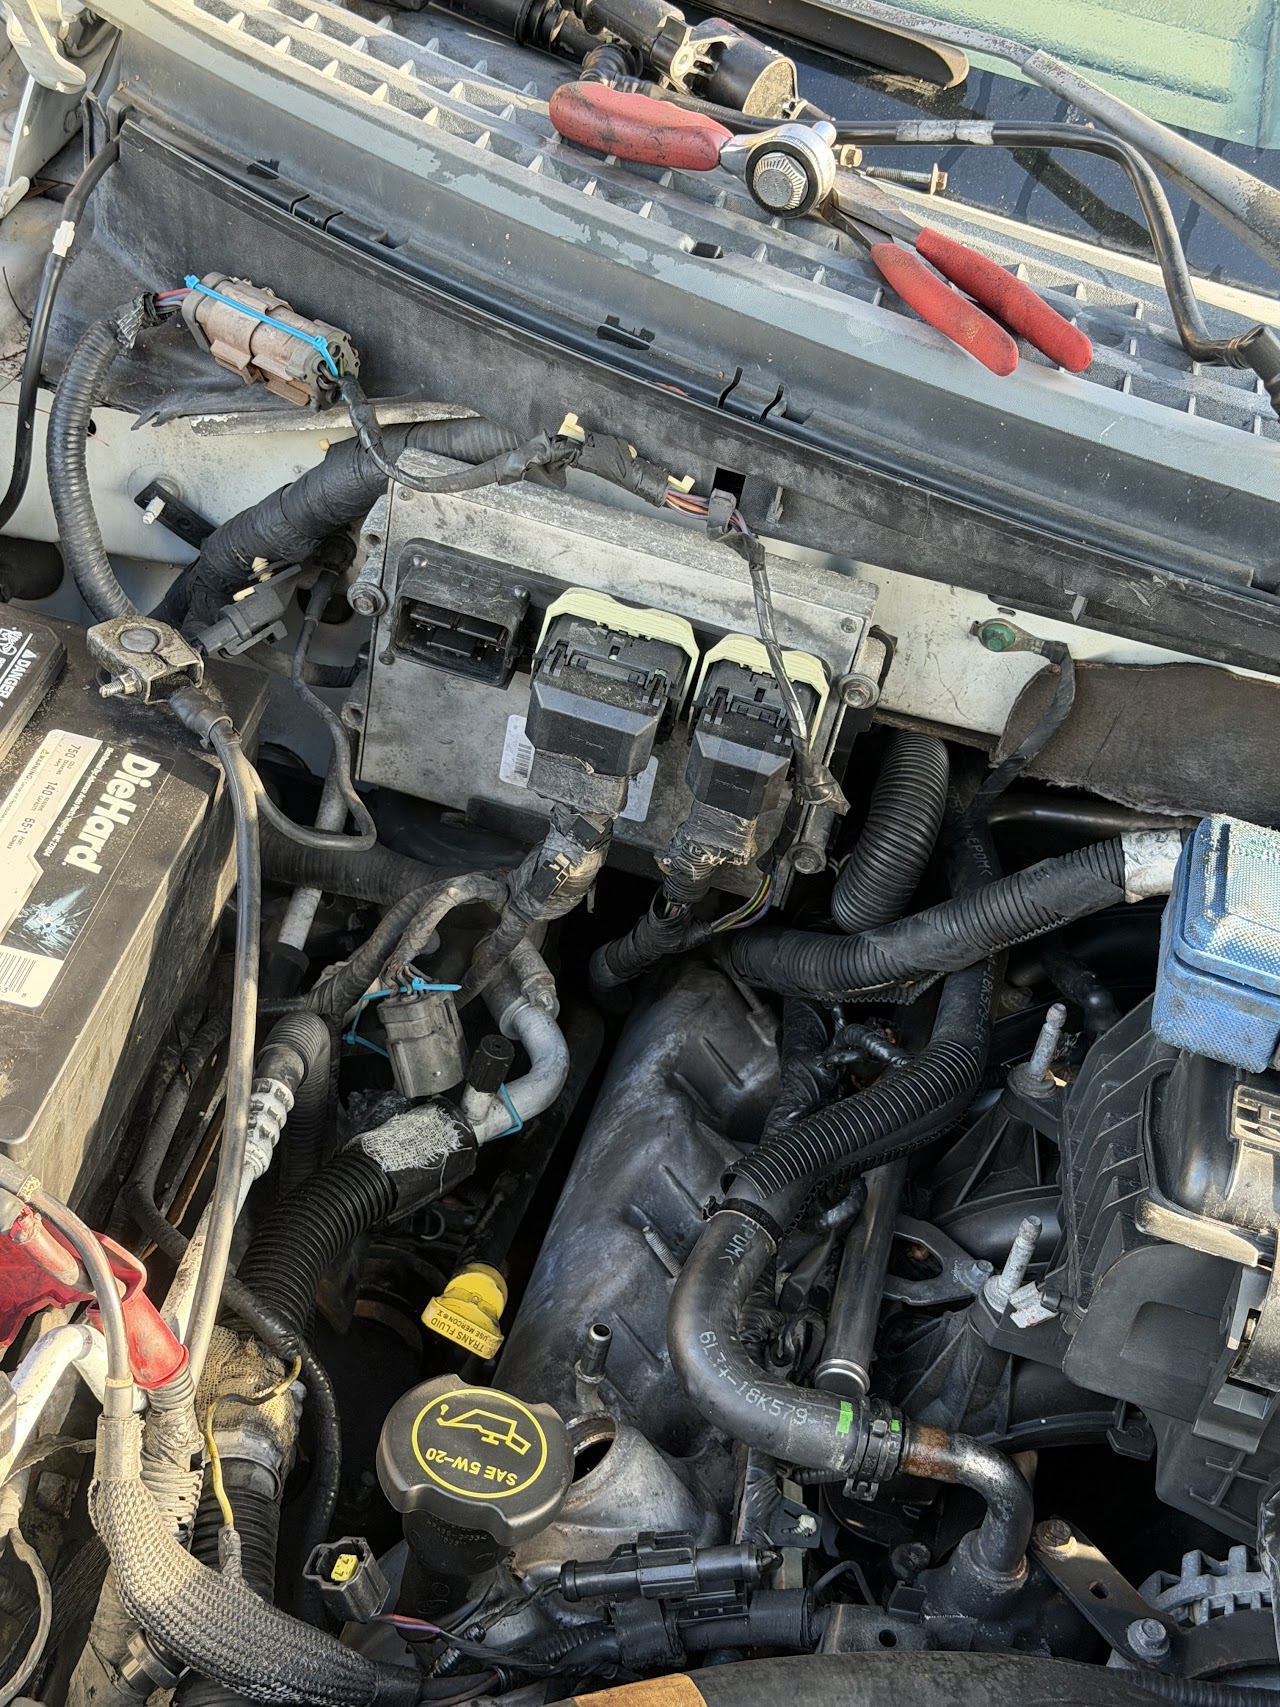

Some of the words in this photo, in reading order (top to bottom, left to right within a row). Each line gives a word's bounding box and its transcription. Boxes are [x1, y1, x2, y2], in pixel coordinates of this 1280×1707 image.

[0, 659, 31, 699] DANGER
[65, 744, 82, 759] 750
[42, 782, 58, 796] 140
[62, 753, 161, 874] DieHard
[16, 817, 36, 835] 65-1
[430, 1318, 454, 1336] FLUID
[474, 1330, 488, 1342] USE
[456, 1332, 484, 1352] TRANS
[425, 1446, 482, 1476] 5W-20
[484, 1465, 518, 1486] SAE
